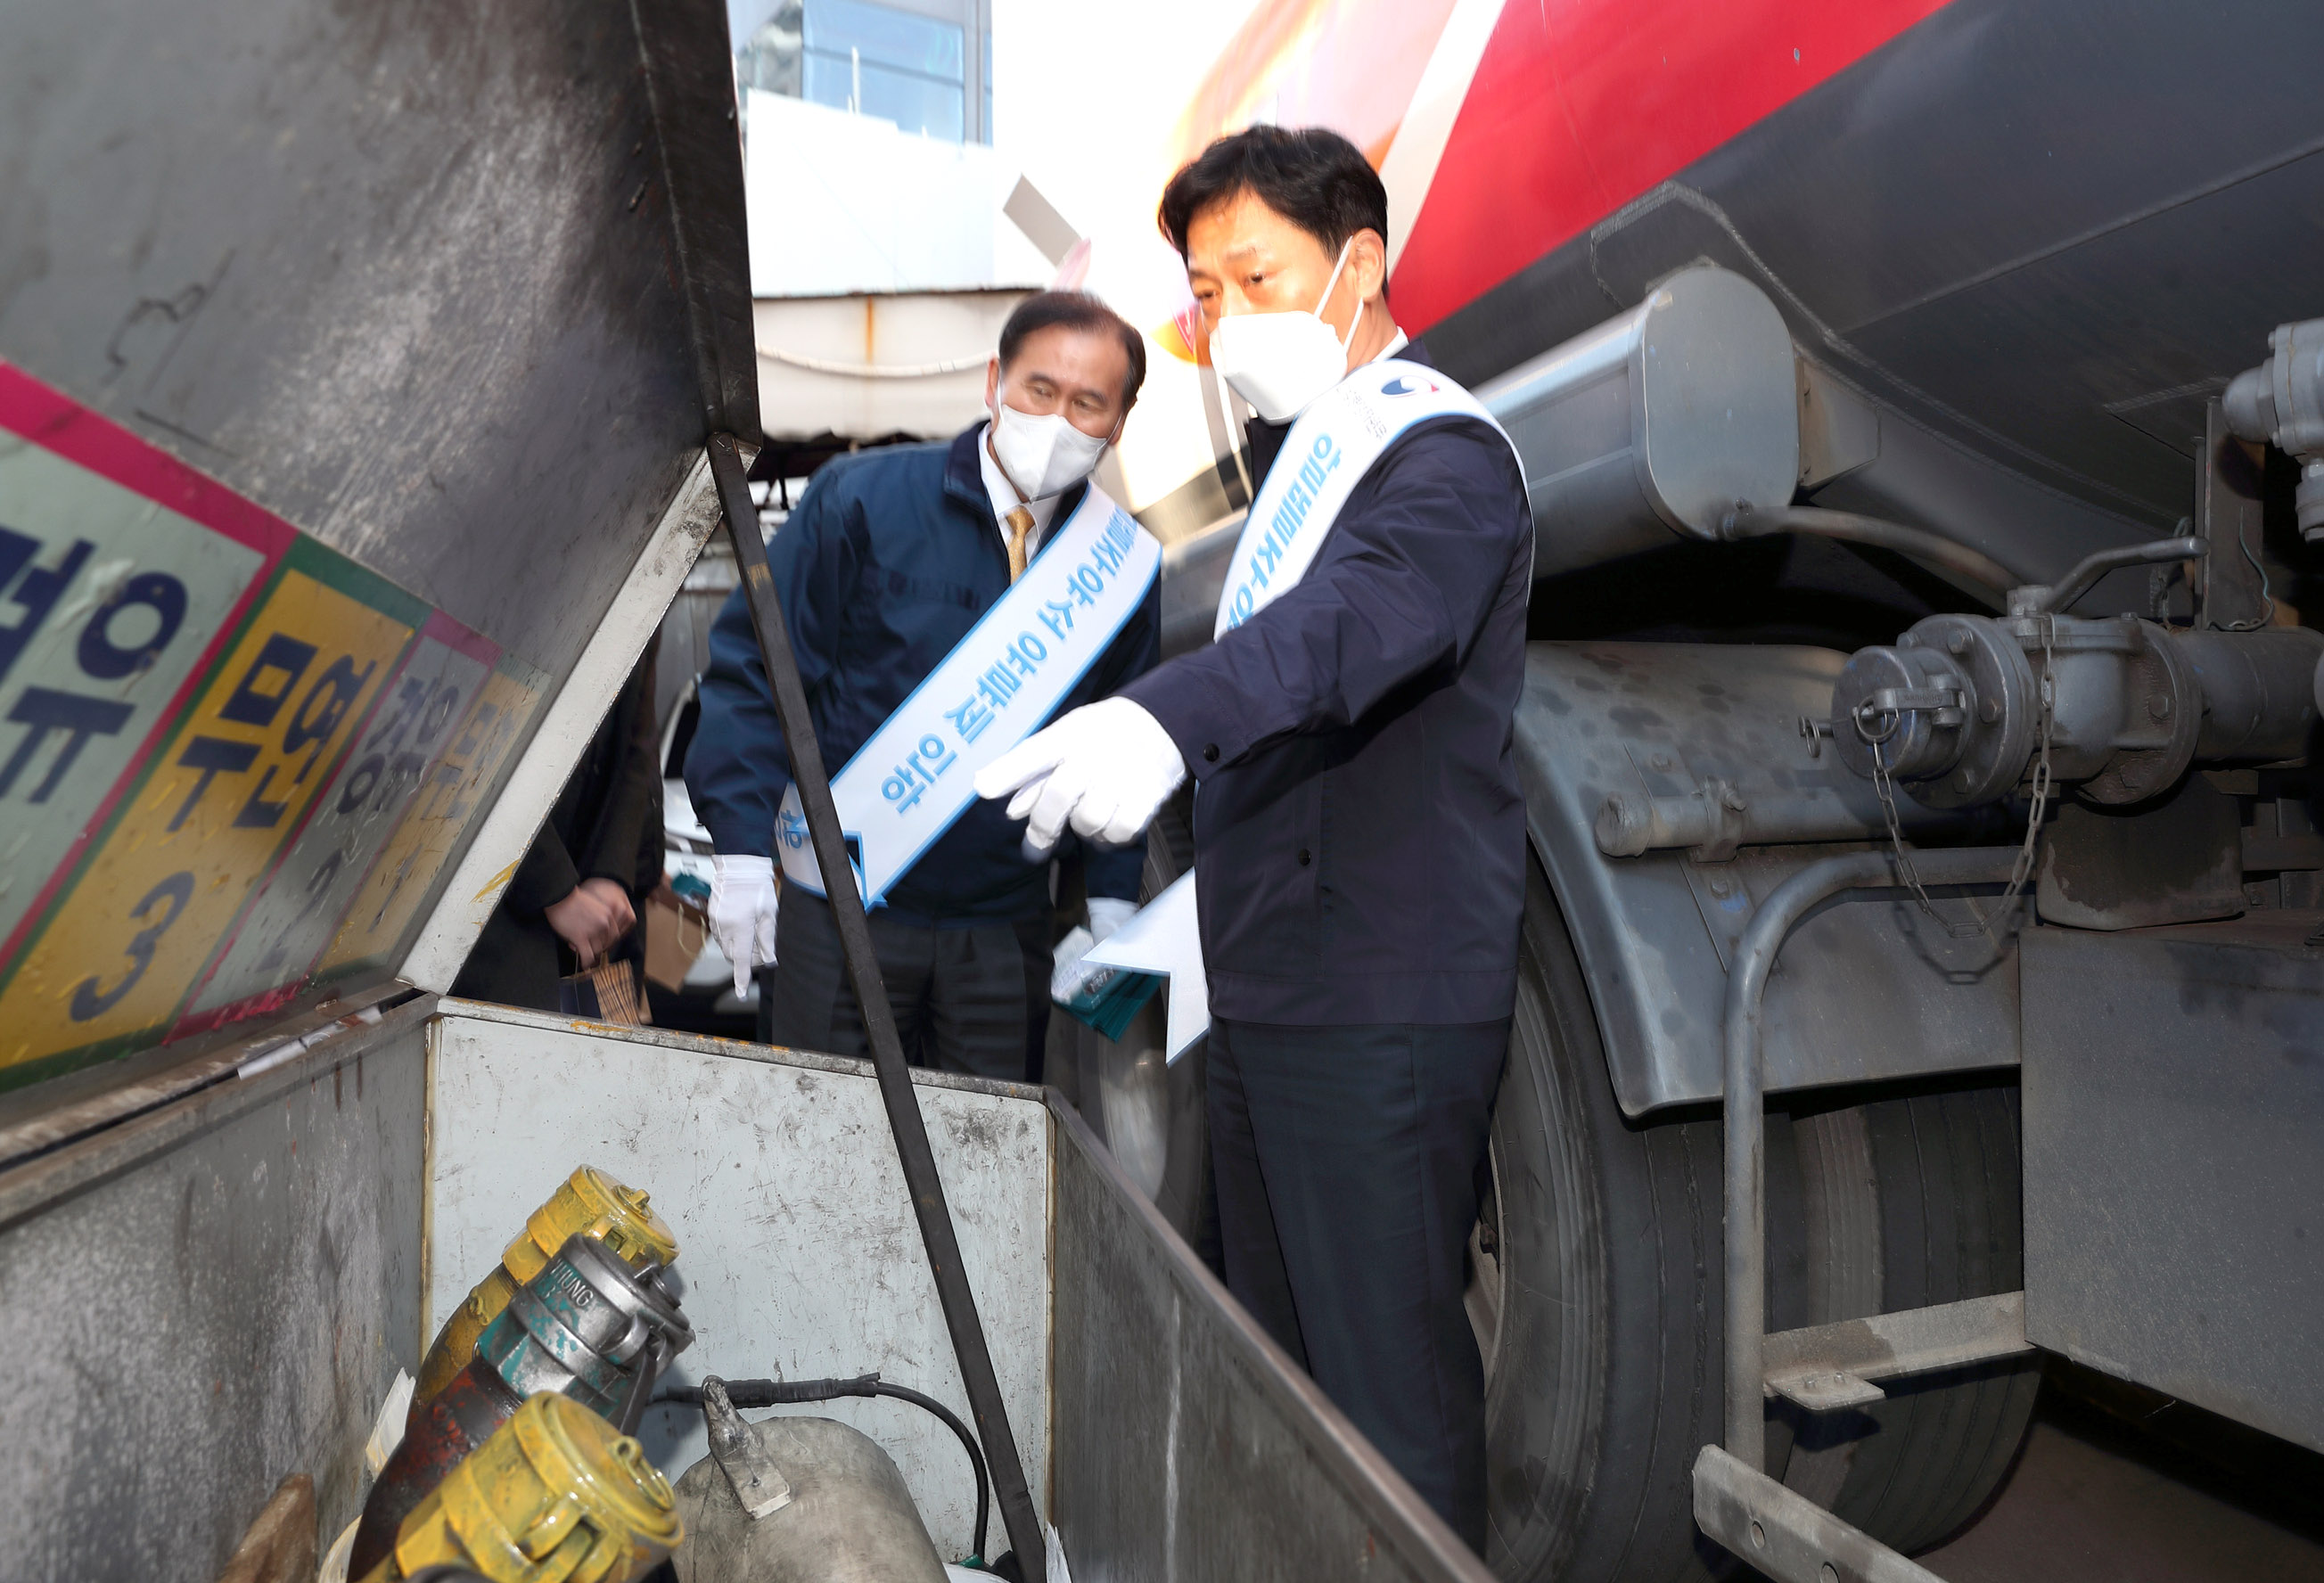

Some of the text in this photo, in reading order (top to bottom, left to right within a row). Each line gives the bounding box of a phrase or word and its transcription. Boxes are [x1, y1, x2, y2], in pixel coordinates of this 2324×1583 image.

[0, 524, 189, 805] 유
[168, 632, 375, 833] 무연
[338, 675, 460, 818] 경유
[880, 505, 1138, 815] 뜰주유소 유류세 인하
[70, 870, 195, 1022] 3
[255, 847, 342, 973] 2
